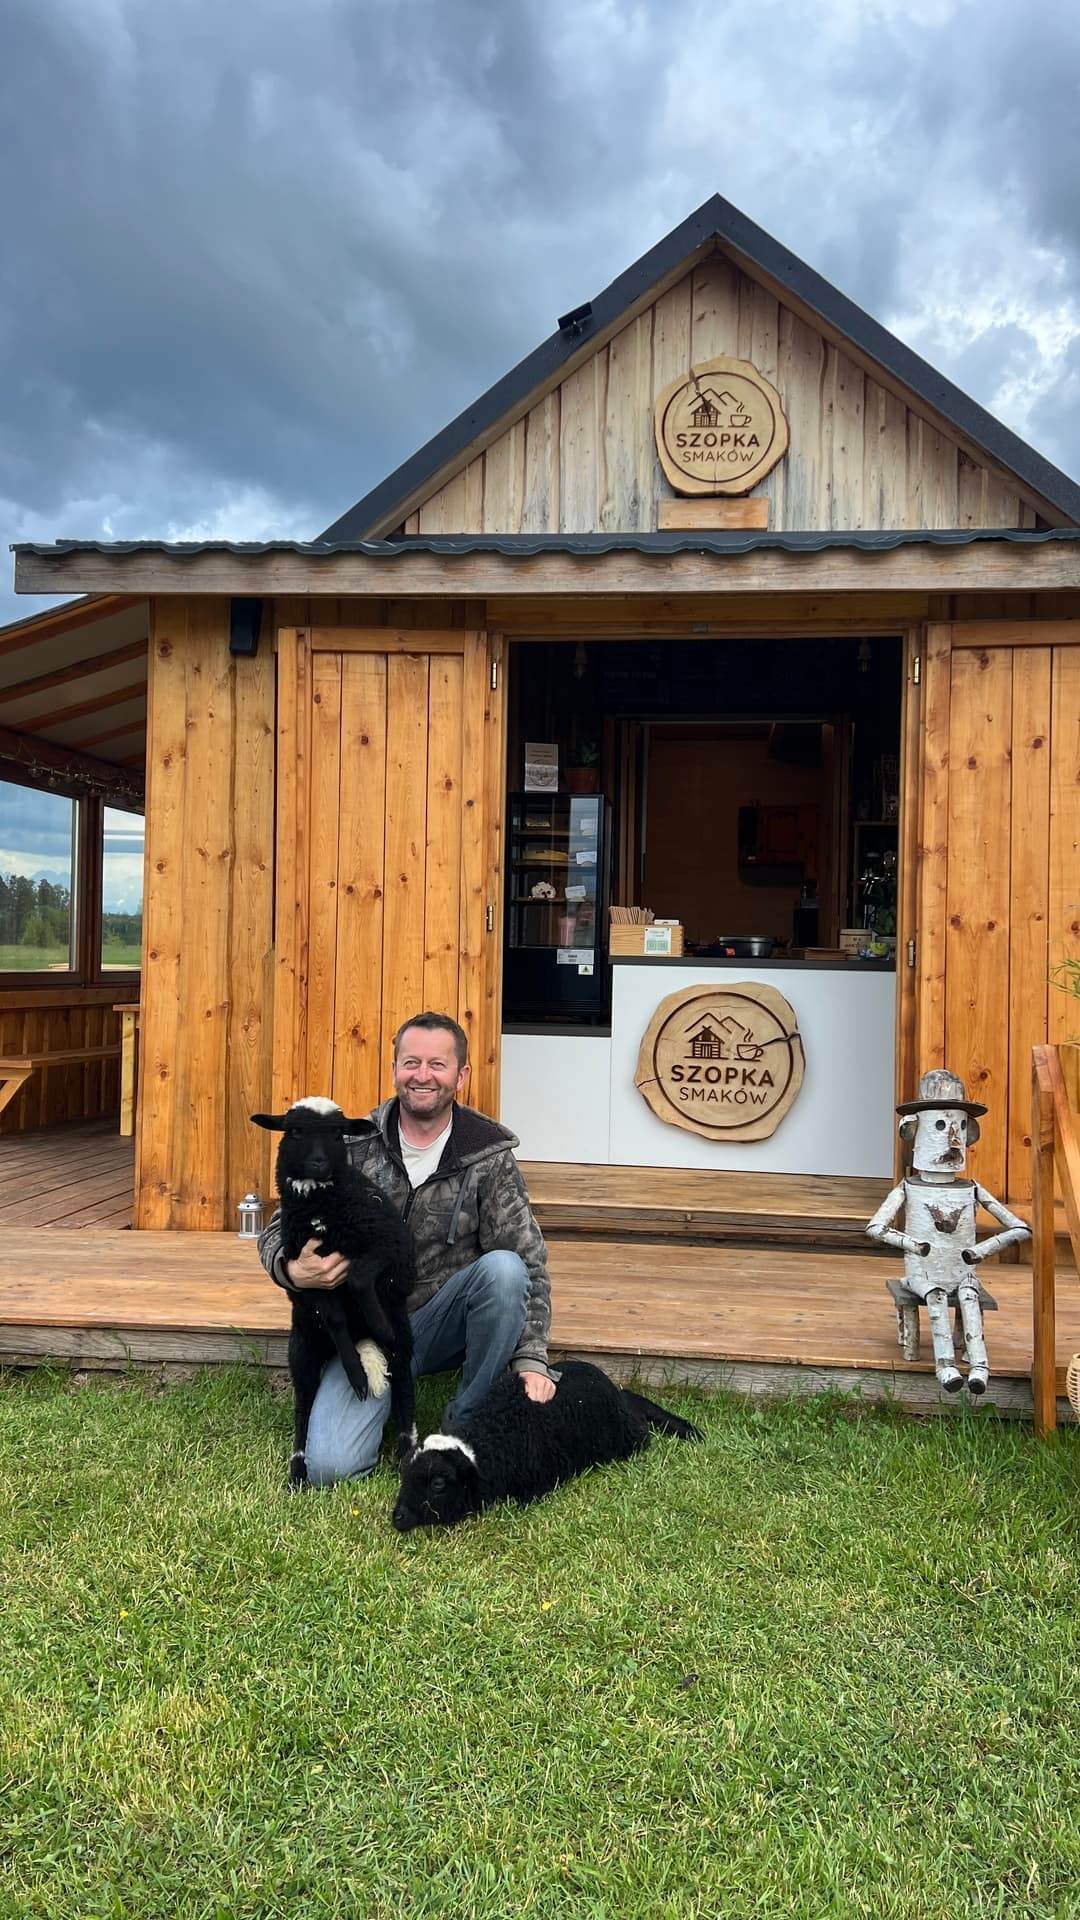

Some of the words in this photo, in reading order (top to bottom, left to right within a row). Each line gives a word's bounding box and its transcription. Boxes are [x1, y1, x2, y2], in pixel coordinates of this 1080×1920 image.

[676, 432, 760, 448] SZOPKA
[682, 449, 754, 463] SMAKÓW
[671, 1064, 774, 1088] SZOPKA
[679, 1086, 768, 1105] SMAKÓW
